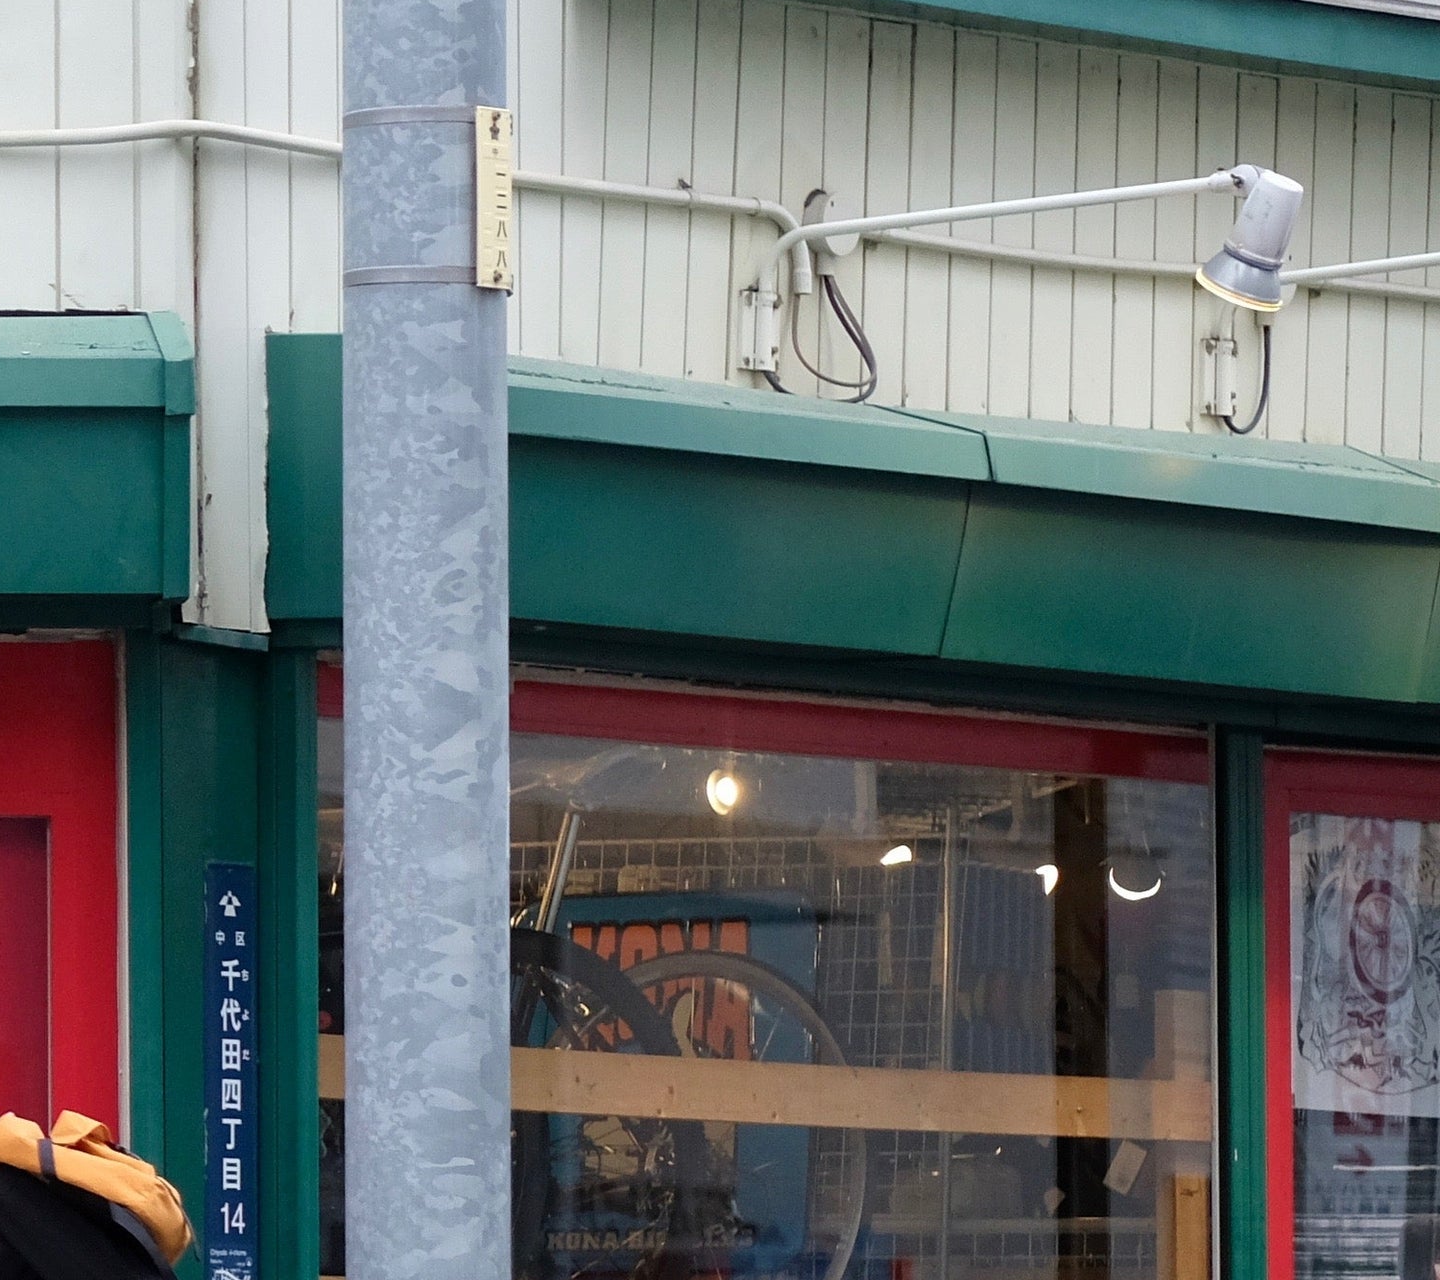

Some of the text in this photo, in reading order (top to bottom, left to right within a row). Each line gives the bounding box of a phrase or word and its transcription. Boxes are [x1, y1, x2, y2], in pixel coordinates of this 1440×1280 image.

[220, 959, 246, 1235] 千代田四丁目 14
